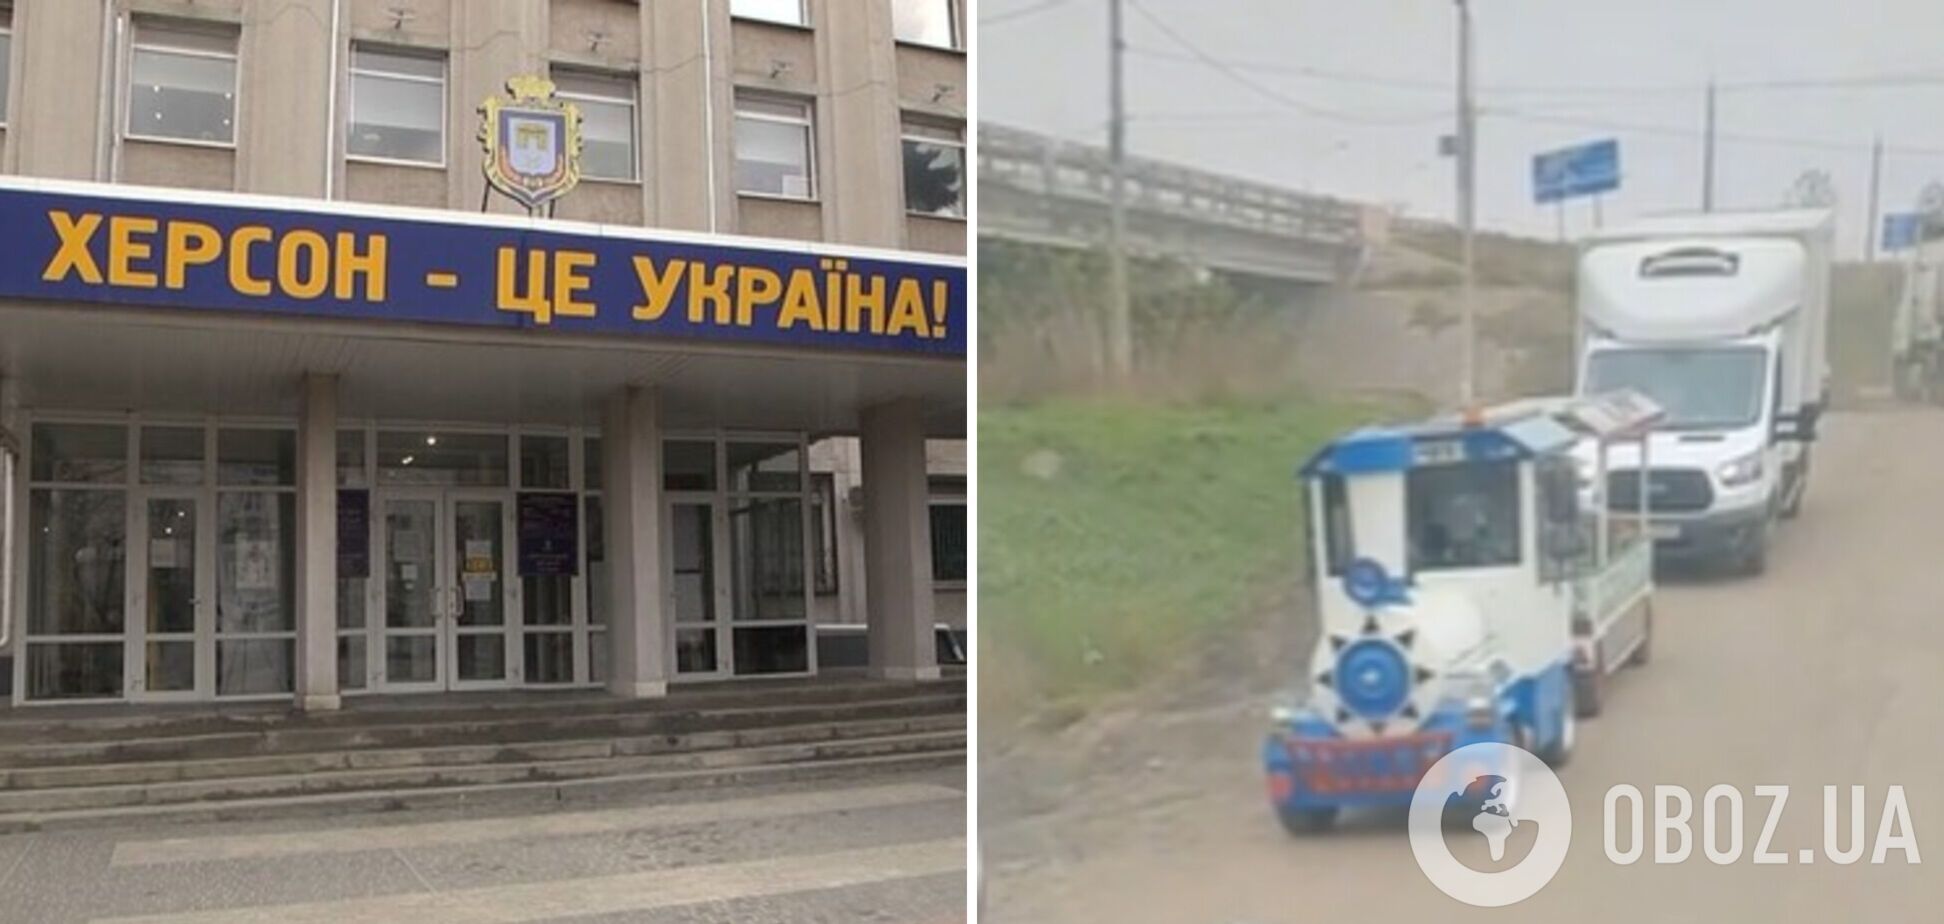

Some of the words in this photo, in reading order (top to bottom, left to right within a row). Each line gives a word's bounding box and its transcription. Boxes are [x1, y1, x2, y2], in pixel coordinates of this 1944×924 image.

[42, 210, 387, 301] ХЕРСОН
[426, 273, 458, 287] -
[496, 247, 597, 323] ЦЕ
[632, 256, 948, 339] УКРАЇНА!
